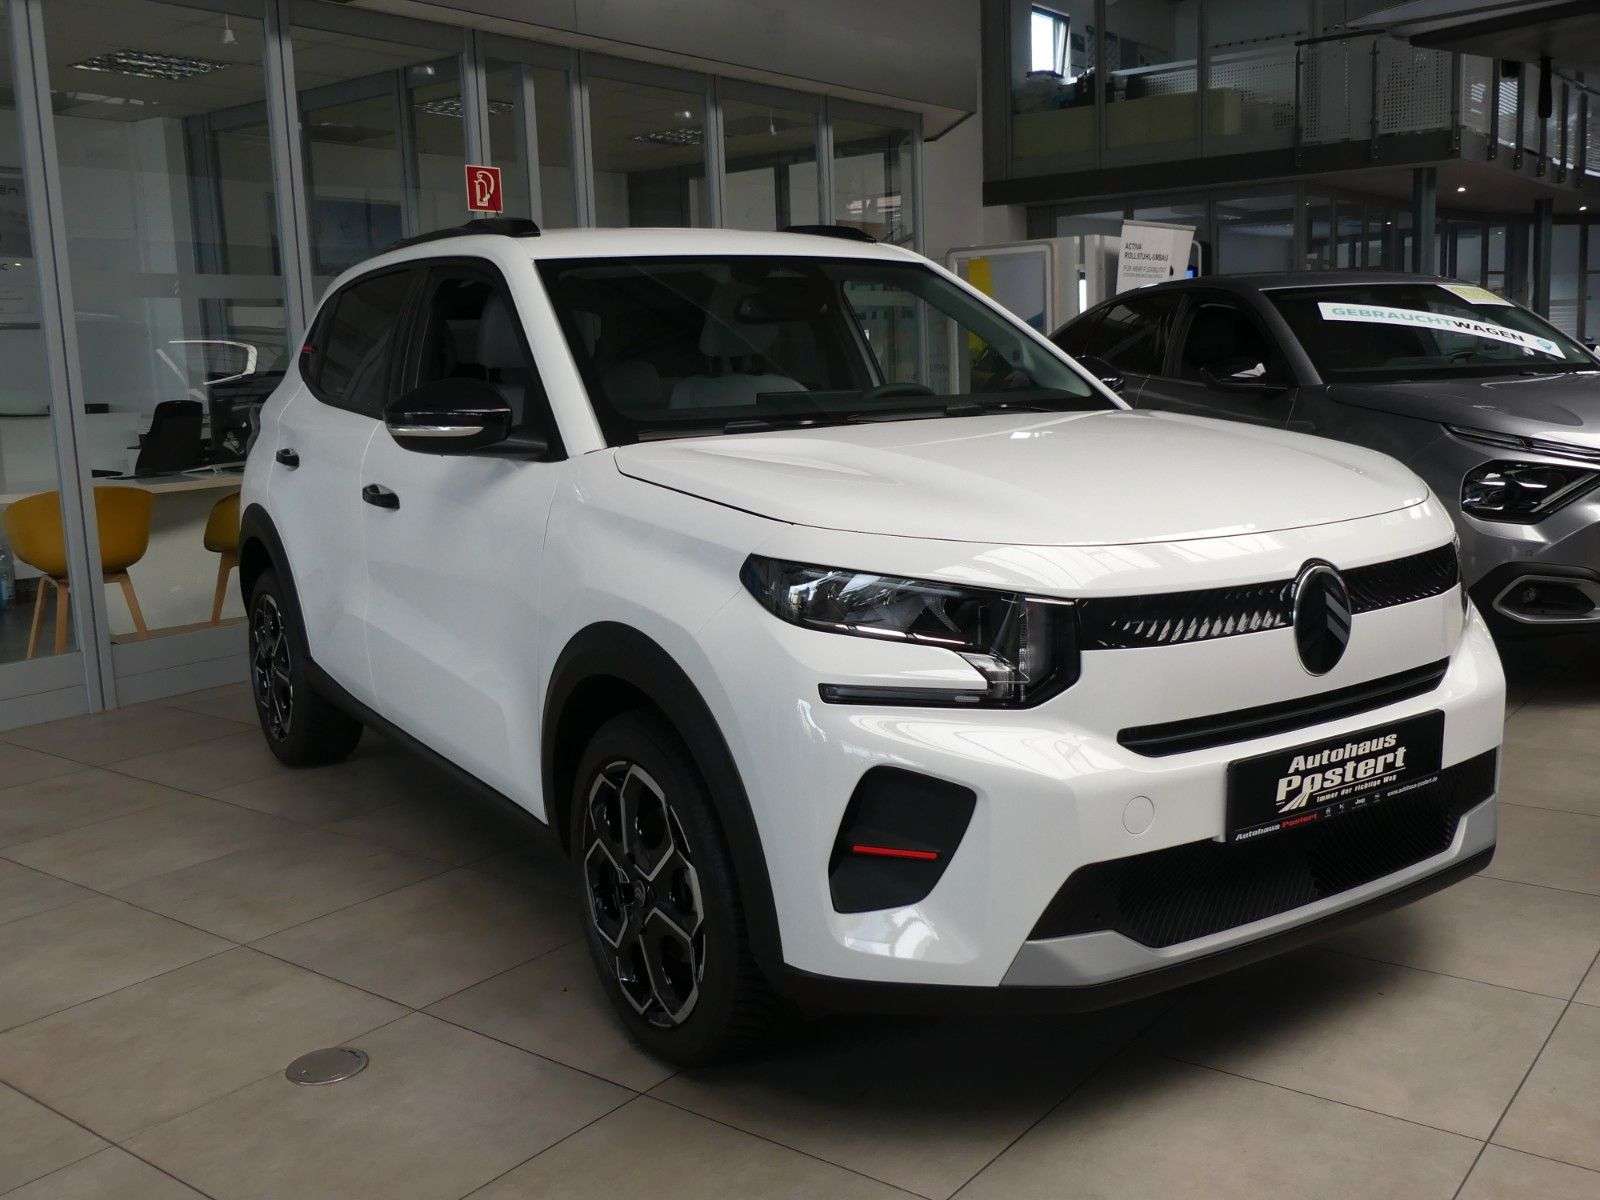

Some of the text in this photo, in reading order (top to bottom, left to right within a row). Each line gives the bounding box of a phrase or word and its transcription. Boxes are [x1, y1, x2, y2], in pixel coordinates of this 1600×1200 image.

[1331, 306, 1525, 343] GEBRAUCHTWAGEN
[1287, 733, 1398, 774] Autohaus
[1275, 746, 1408, 809] Postert
[1235, 813, 1318, 841] Autohaus Postert
